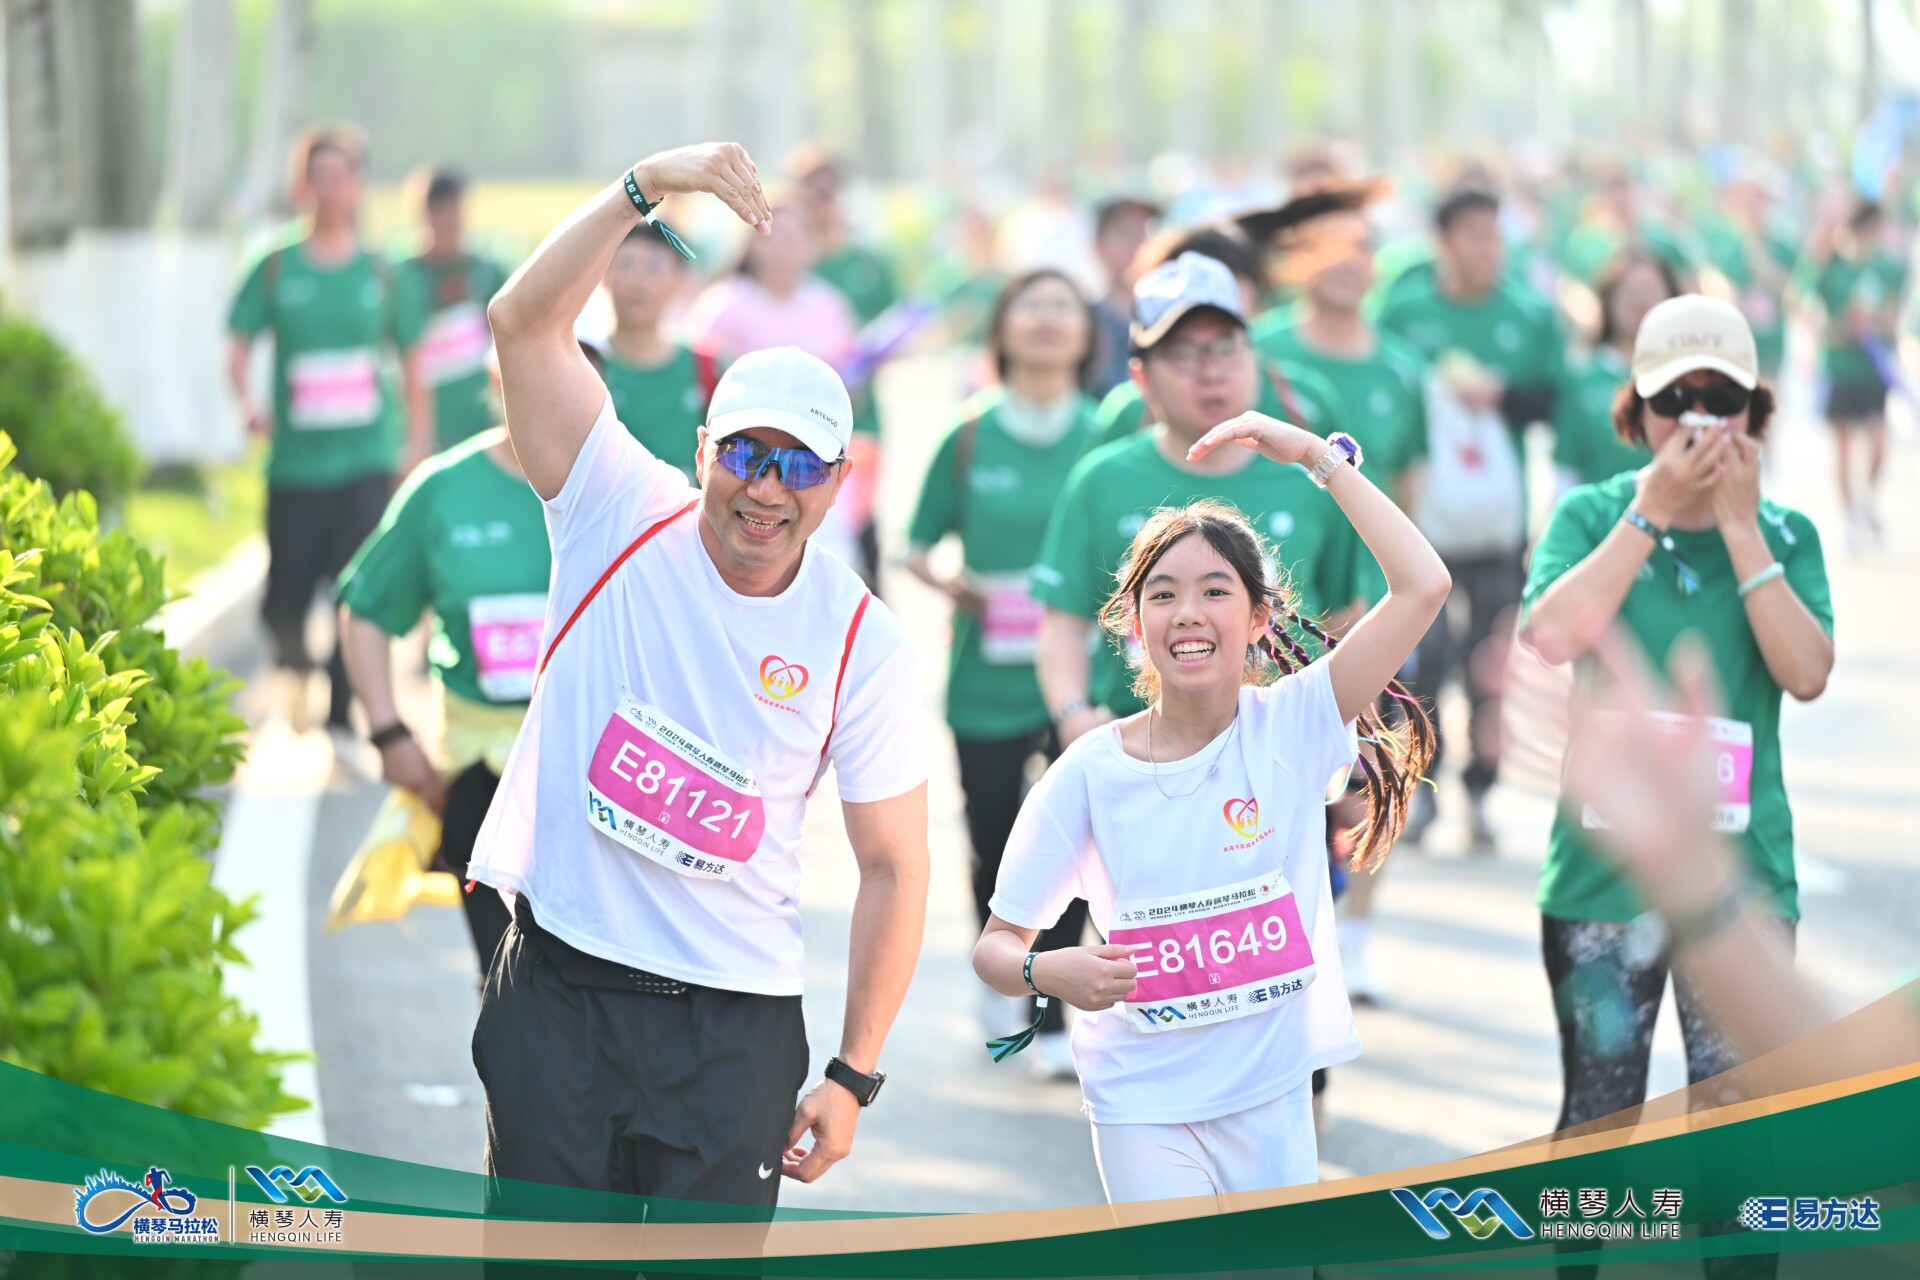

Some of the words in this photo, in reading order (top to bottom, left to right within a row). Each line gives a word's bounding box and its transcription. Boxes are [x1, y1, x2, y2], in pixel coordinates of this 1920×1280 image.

[609, 739, 751, 840] E81121
[619, 828, 650, 849] HENGQIN
[651, 845, 665, 857] LIFE
[624, 818, 671, 850] 横琴人寿
[693, 858, 726, 875] 易方达
[1129, 915, 1287, 979] E81649
[1268, 978, 1303, 999] 易方达
[1186, 993, 1238, 1012] 横琴人寿
[1189, 1009, 1223, 1019] HENGQIN
[1225, 1005, 1239, 1013] LIFE
